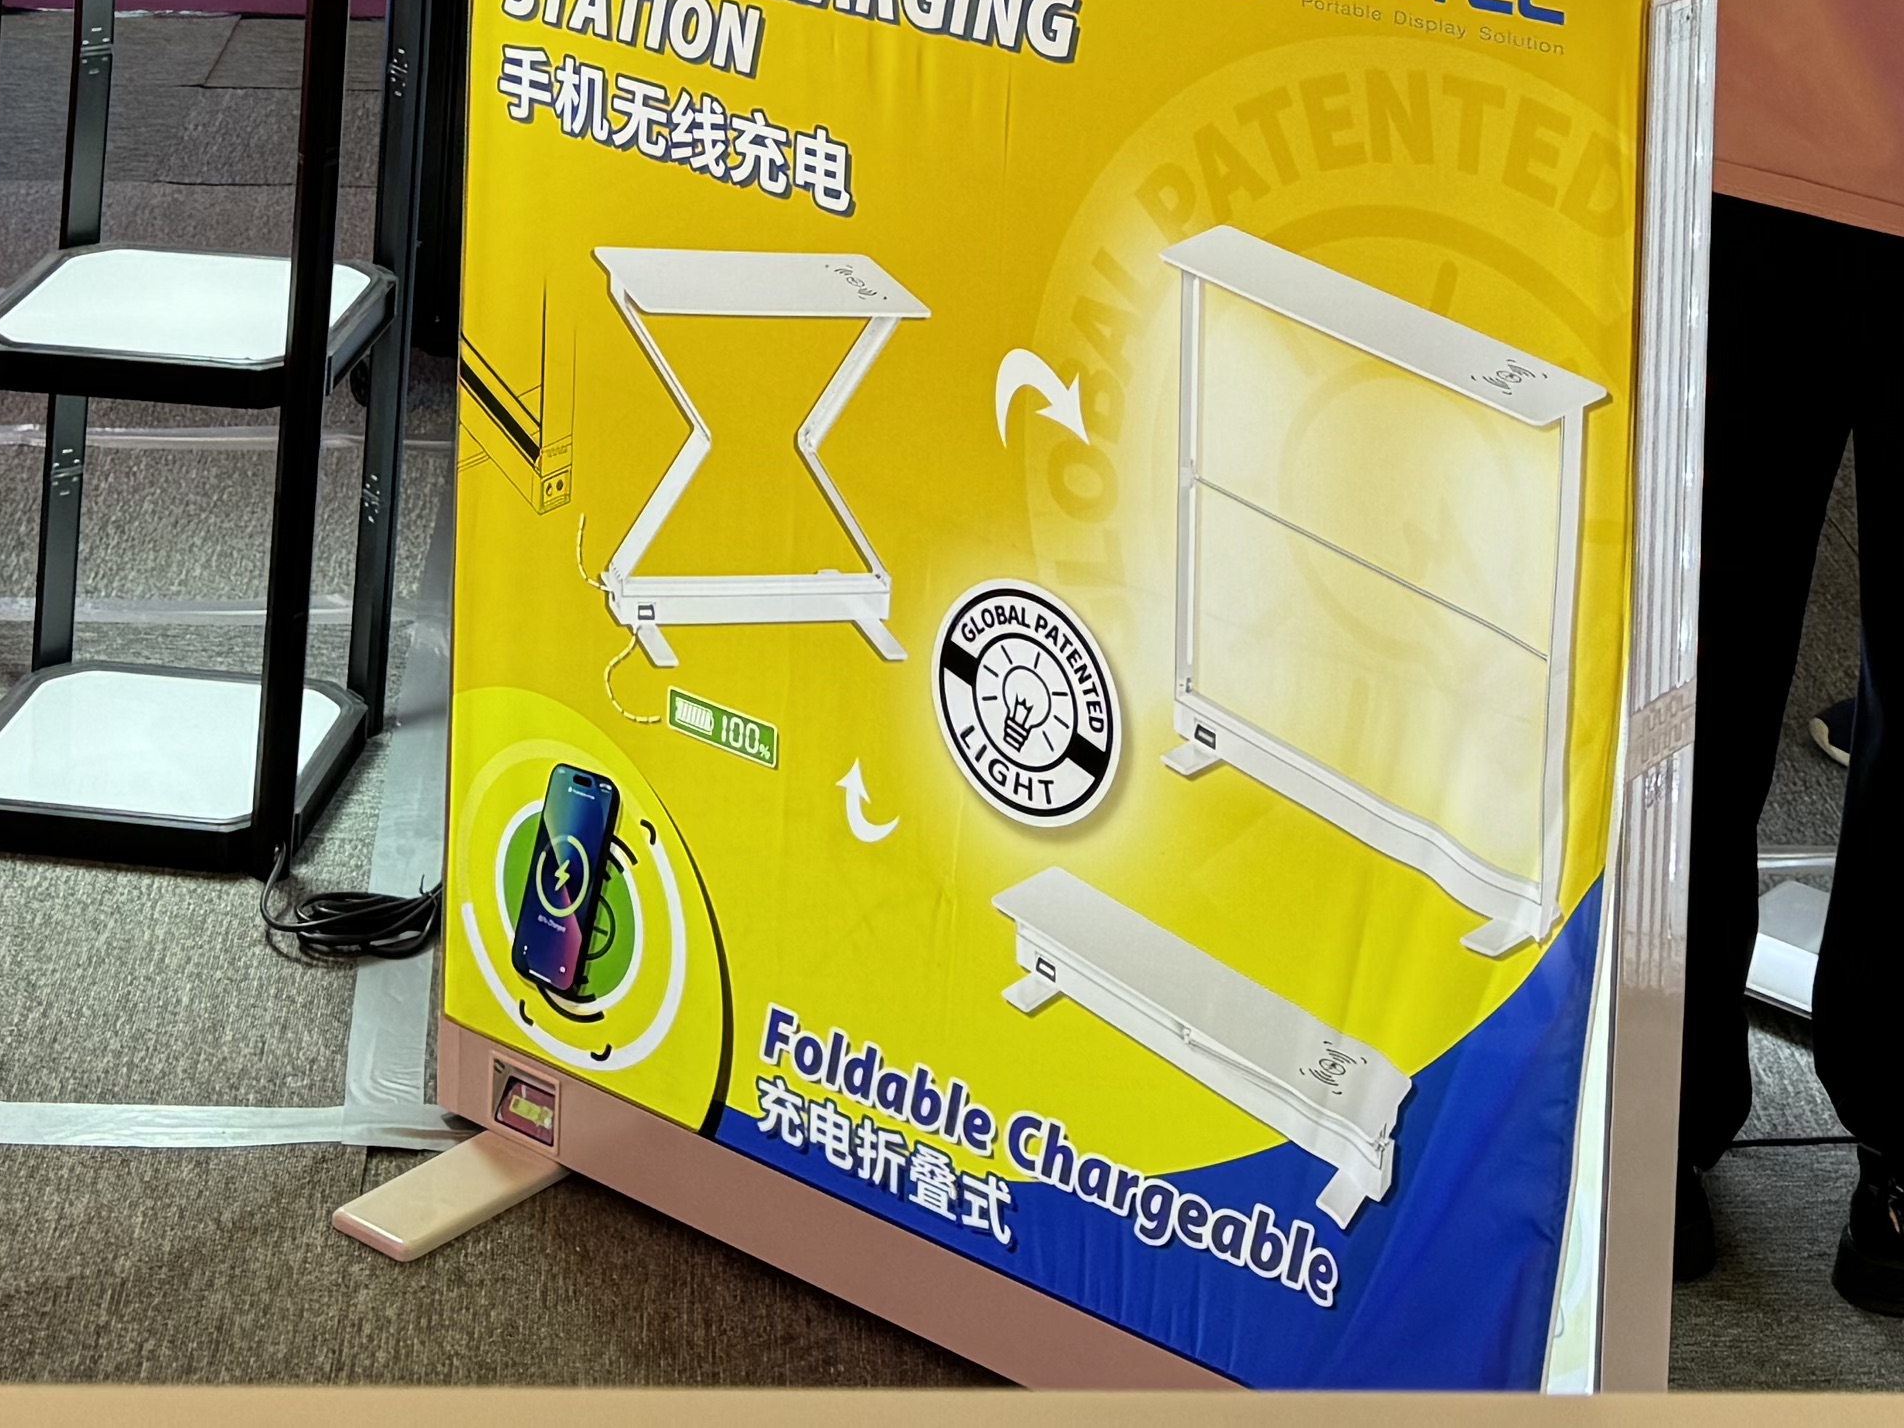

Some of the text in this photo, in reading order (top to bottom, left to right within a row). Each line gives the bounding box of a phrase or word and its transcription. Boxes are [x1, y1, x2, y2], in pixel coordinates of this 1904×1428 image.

[1393, 7, 1468, 41] Display
[1478, 23, 1566, 56] Solution
[496, 45, 856, 216] 手机无线充电
[960, 604, 1105, 734] GLOBAL PATENTED
[718, 714, 771, 761] 100%
[959, 724, 1055, 806] LIGHT
[754, 1075, 1014, 1249] 充电折叠式
[760, 1001, 1340, 1307] Foldable Chargeable
